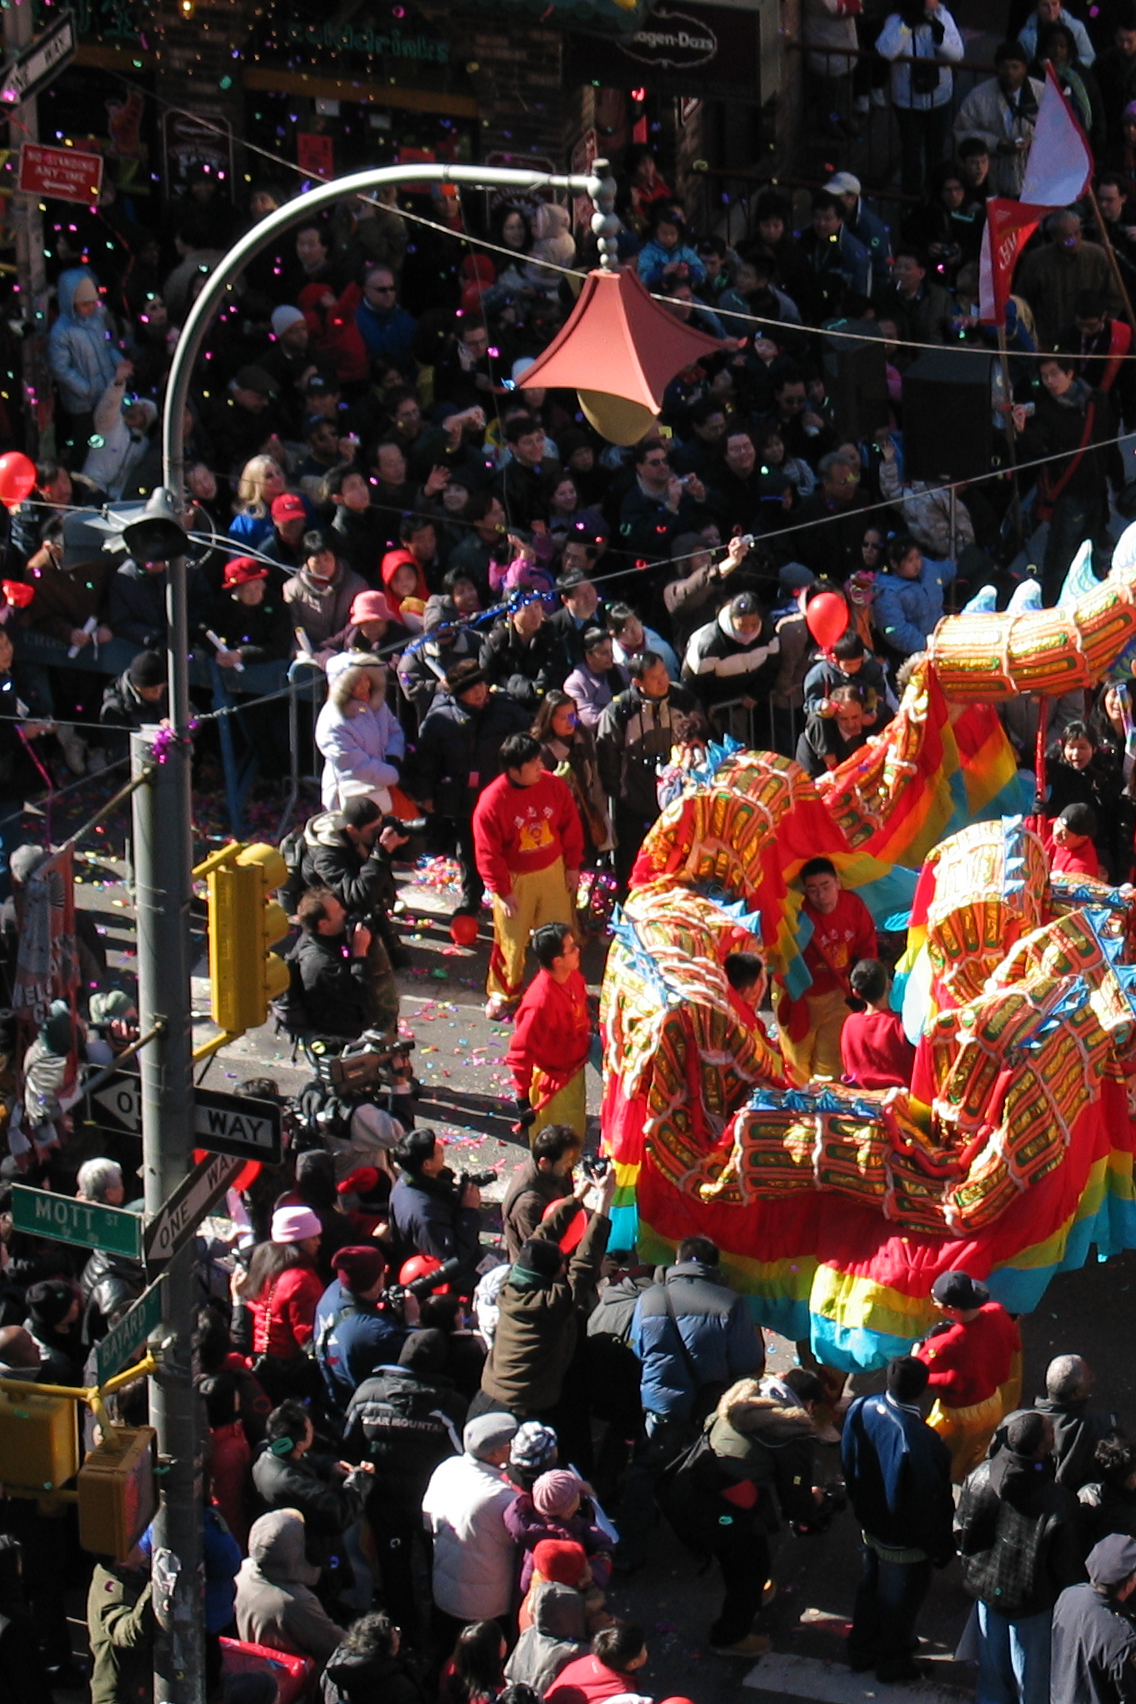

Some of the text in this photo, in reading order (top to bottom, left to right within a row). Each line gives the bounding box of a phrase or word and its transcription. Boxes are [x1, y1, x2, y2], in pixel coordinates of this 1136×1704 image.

[634, 31, 714, 50] agen-Dazs
[208, 1109, 264, 1142] WAY
[34, 1196, 119, 1230] MOTT ST
[159, 1200, 190, 1249] ONE
[102, 1303, 147, 1368] BAYARD
